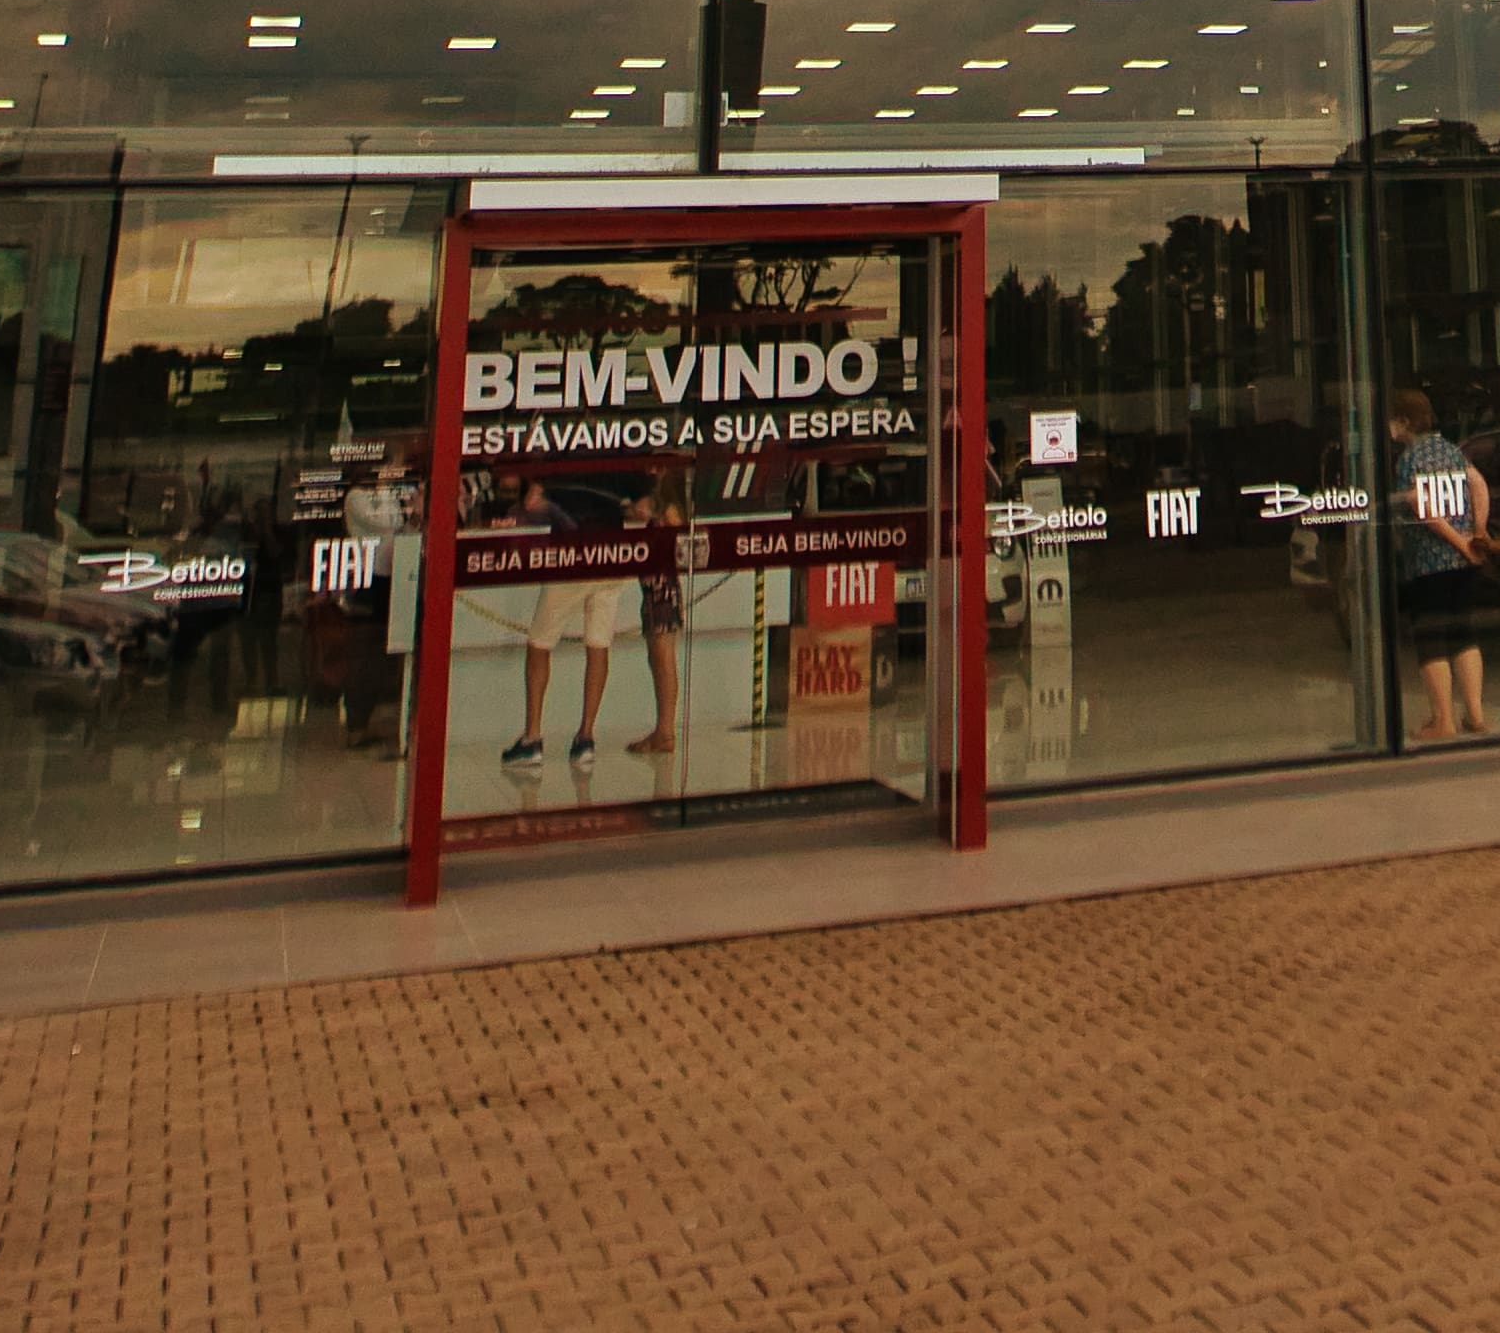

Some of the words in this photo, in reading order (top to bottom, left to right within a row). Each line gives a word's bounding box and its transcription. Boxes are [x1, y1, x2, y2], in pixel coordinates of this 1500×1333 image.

[463, 338, 879, 412] BEM-VINDO
[461, 415, 669, 456] ESTÁVAMOS
[677, 417, 704, 448] A
[713, 413, 781, 444] SUA
[789, 407, 916, 442] ESPERA
[984, 499, 1109, 537] Betiolo
[1145, 488, 1201, 539] FIAT
[1240, 482, 1370, 520] Betiolo
[1415, 472, 1468, 520] FIAT
[466, 549, 523, 573] SEJA
[528, 541, 651, 570] BEM-VINDO
[735, 532, 788, 557] SEJA
[793, 525, 908, 553] BEM-VINDO
[77, 548, 246, 594] Betiolo
[311, 535, 381, 594] FIAT
[825, 561, 880, 608] FIAT
[795, 668, 864, 697] HARD
